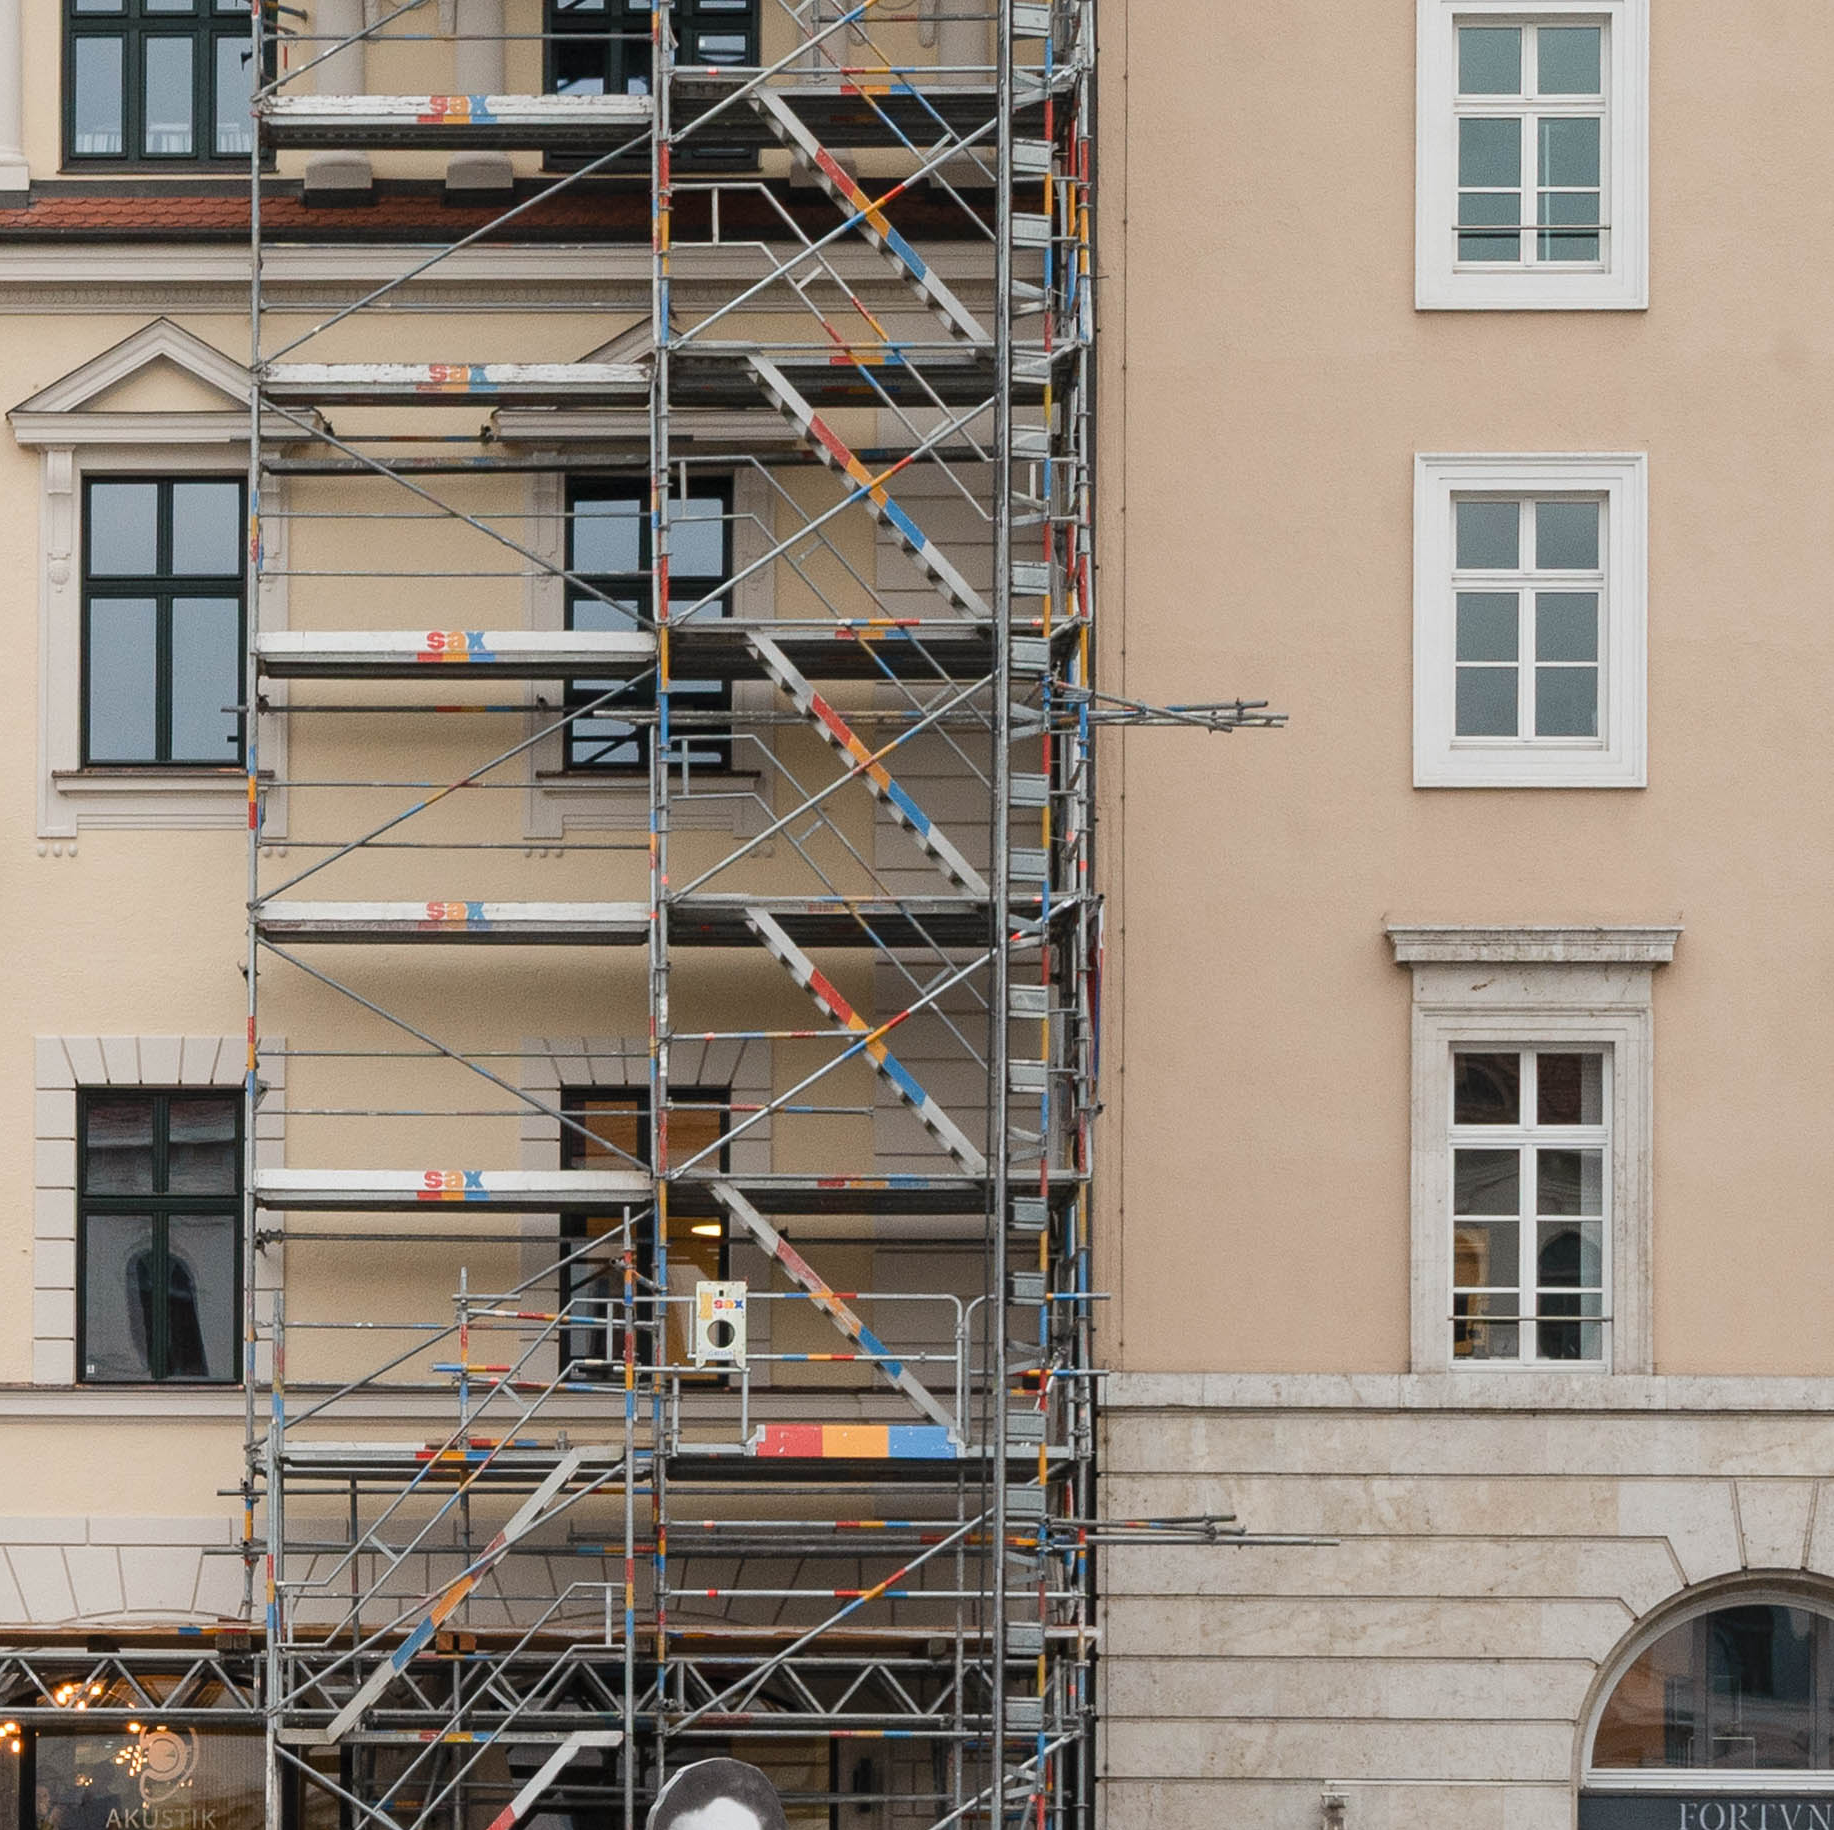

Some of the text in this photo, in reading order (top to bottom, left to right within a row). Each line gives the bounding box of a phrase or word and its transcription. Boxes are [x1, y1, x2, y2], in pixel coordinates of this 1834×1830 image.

[429, 94, 488, 115] sax
[429, 365, 488, 384] sax
[427, 631, 485, 651] sax
[427, 901, 485, 920] sax
[423, 1170, 483, 1191] sax
[714, 1299, 744, 1309] sax
[106, 1807, 216, 1830] AKUSTIK
